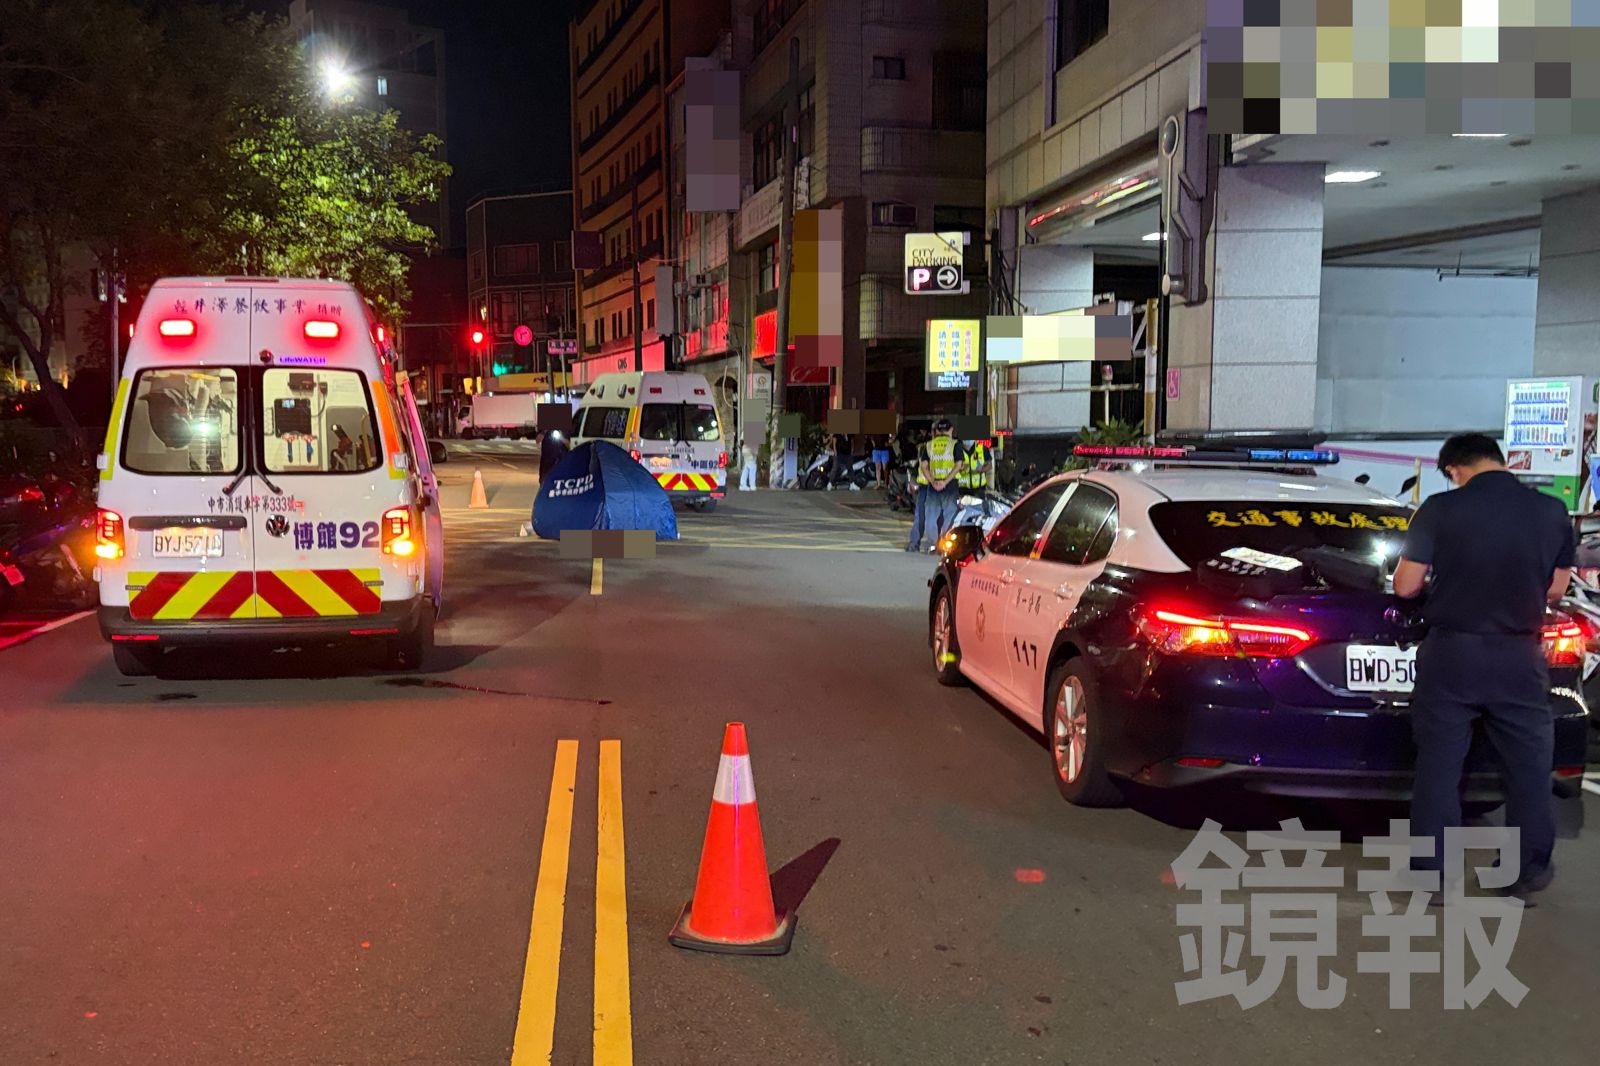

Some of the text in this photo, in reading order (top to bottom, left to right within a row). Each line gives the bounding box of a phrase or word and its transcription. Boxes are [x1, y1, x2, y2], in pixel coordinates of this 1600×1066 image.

[912, 247, 935, 257] CITY
[912, 256, 958, 266] PARKING
[913, 268, 930, 291] P
[553, 473, 594, 490] TCPD
[1013, 636, 1037, 671] 117
